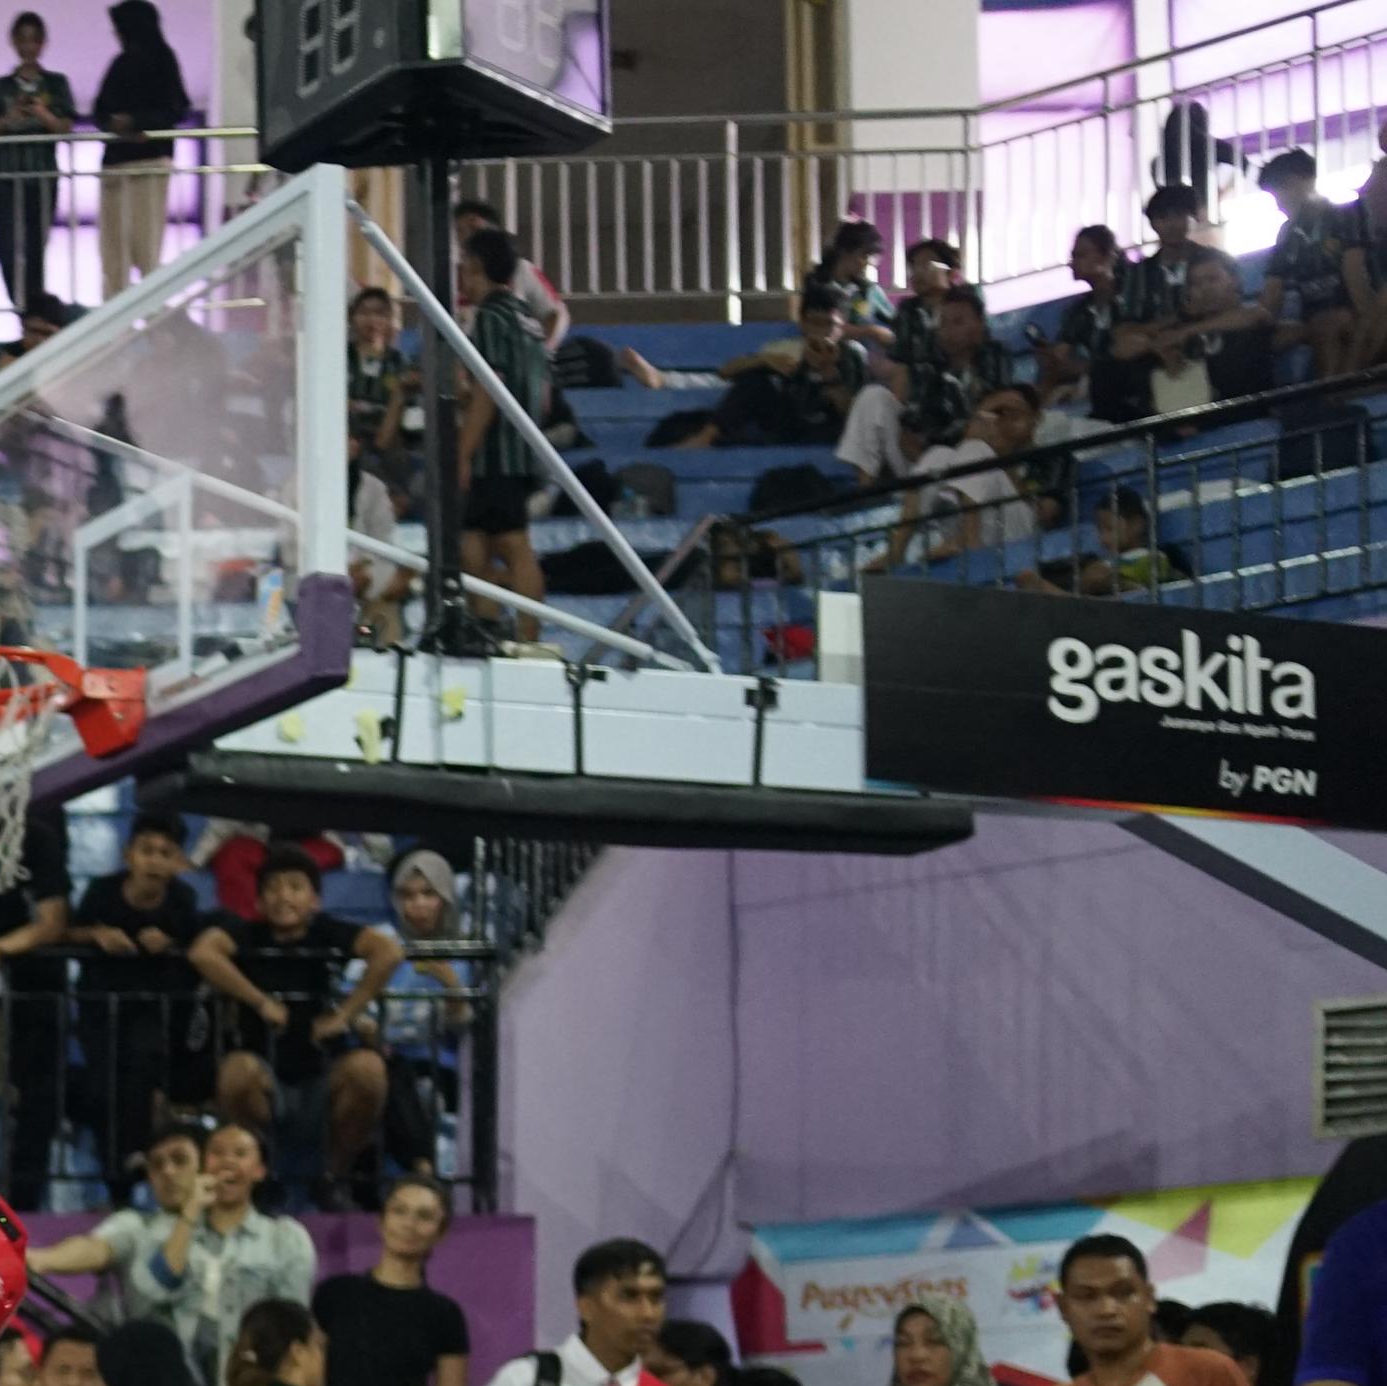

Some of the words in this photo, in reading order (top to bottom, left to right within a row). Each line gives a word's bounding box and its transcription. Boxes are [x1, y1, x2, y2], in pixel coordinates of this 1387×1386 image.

[1047, 629, 1317, 724] gaskita
[1218, 759, 1249, 797] by
[1252, 765, 1318, 797] PGN
